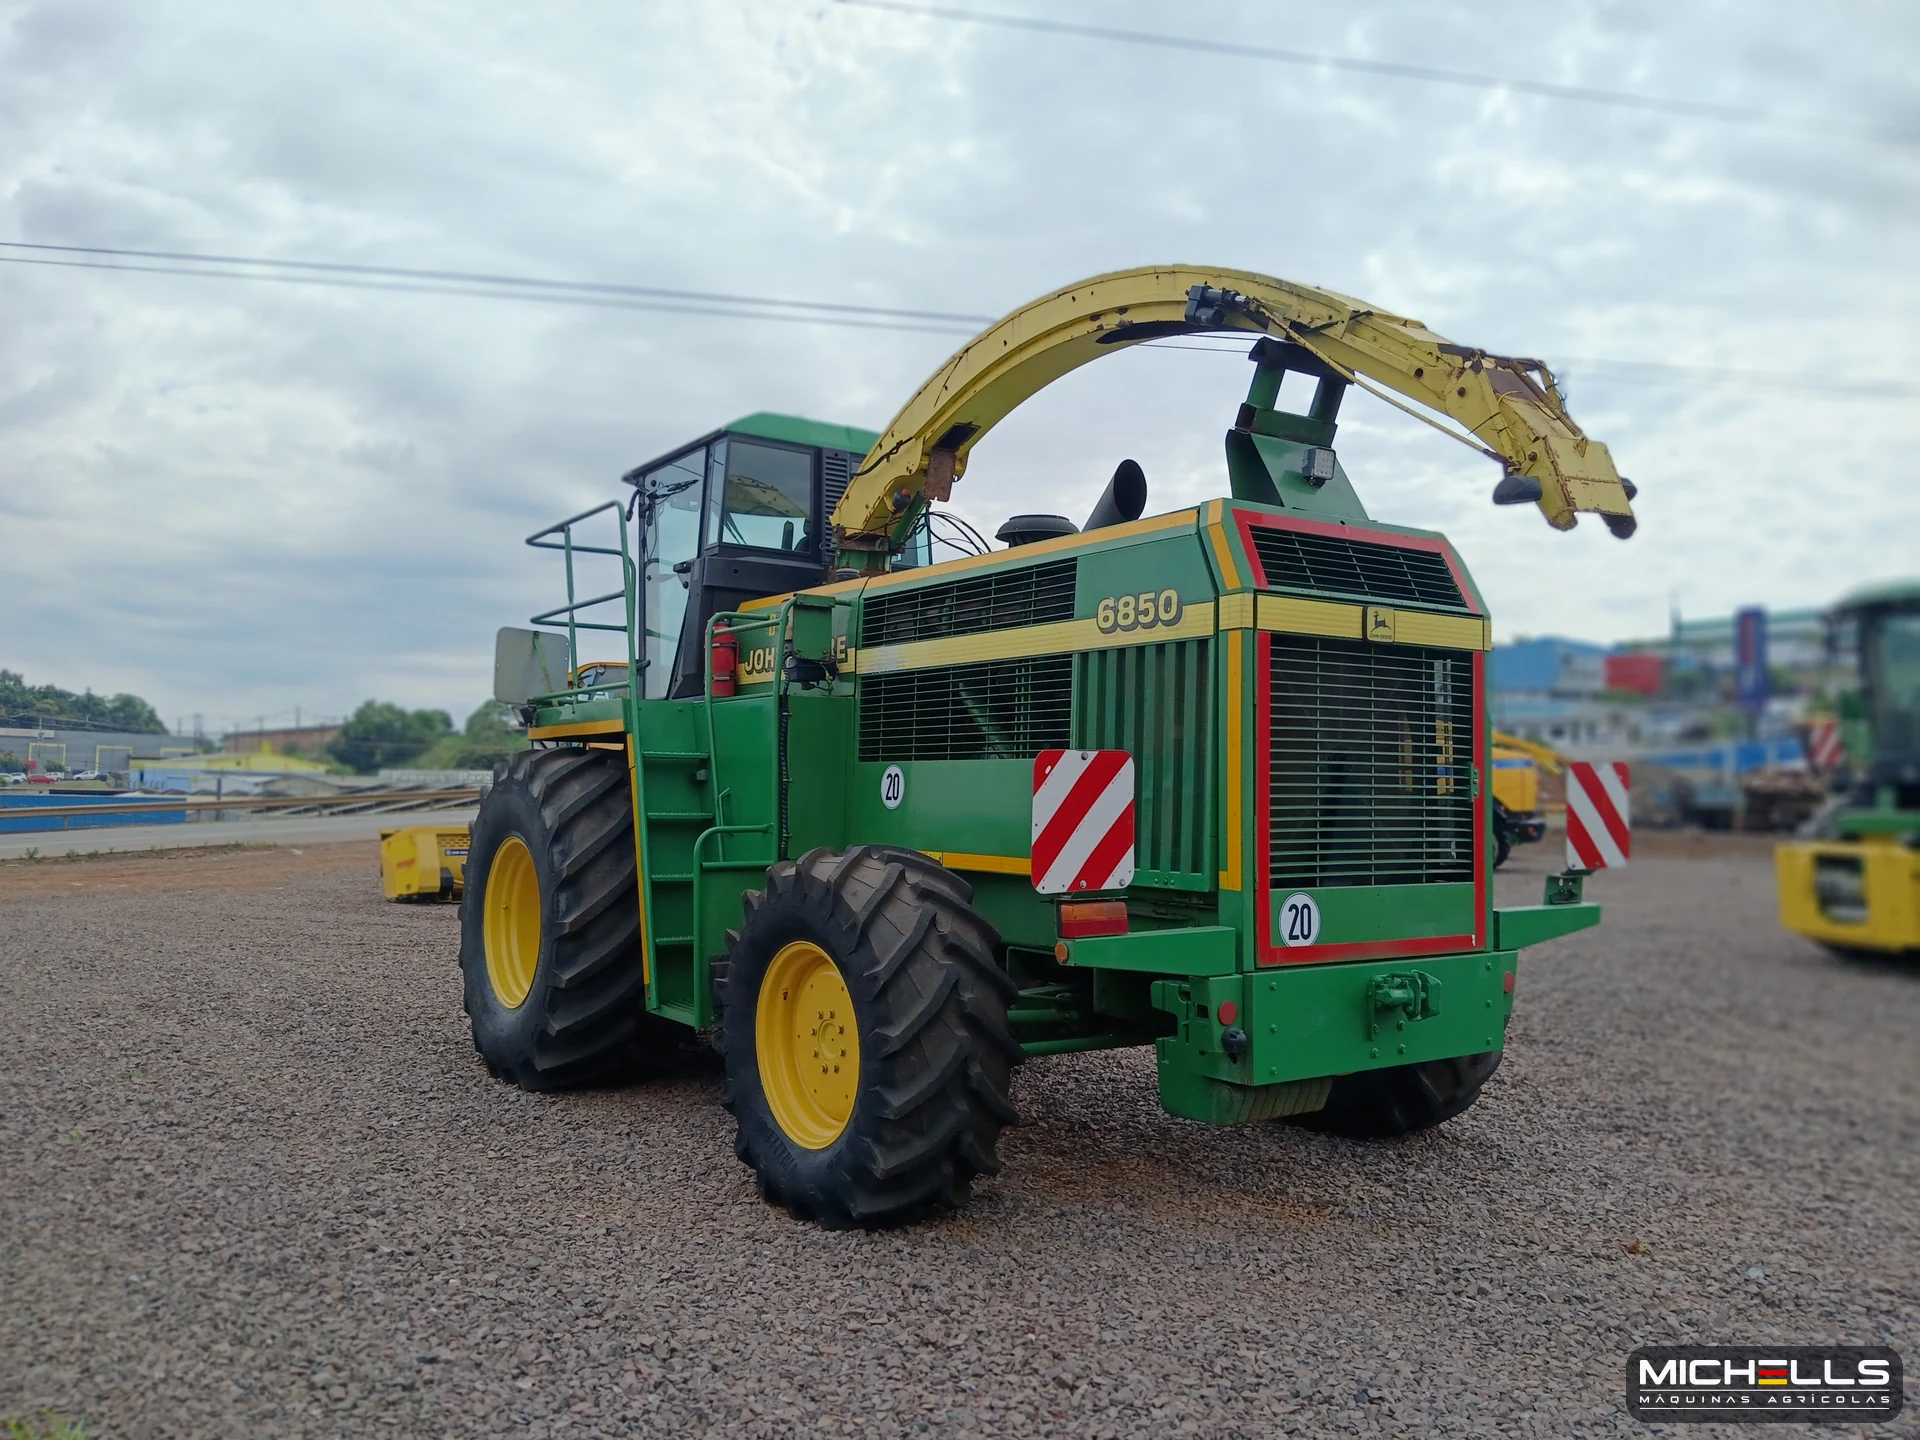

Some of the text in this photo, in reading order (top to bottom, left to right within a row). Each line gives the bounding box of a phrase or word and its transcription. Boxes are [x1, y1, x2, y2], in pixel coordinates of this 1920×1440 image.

[1097, 588, 1182, 633] 6850
[745, 646, 776, 675] JOH
[885, 772, 900, 801] 20
[1287, 903, 1312, 941] 20
